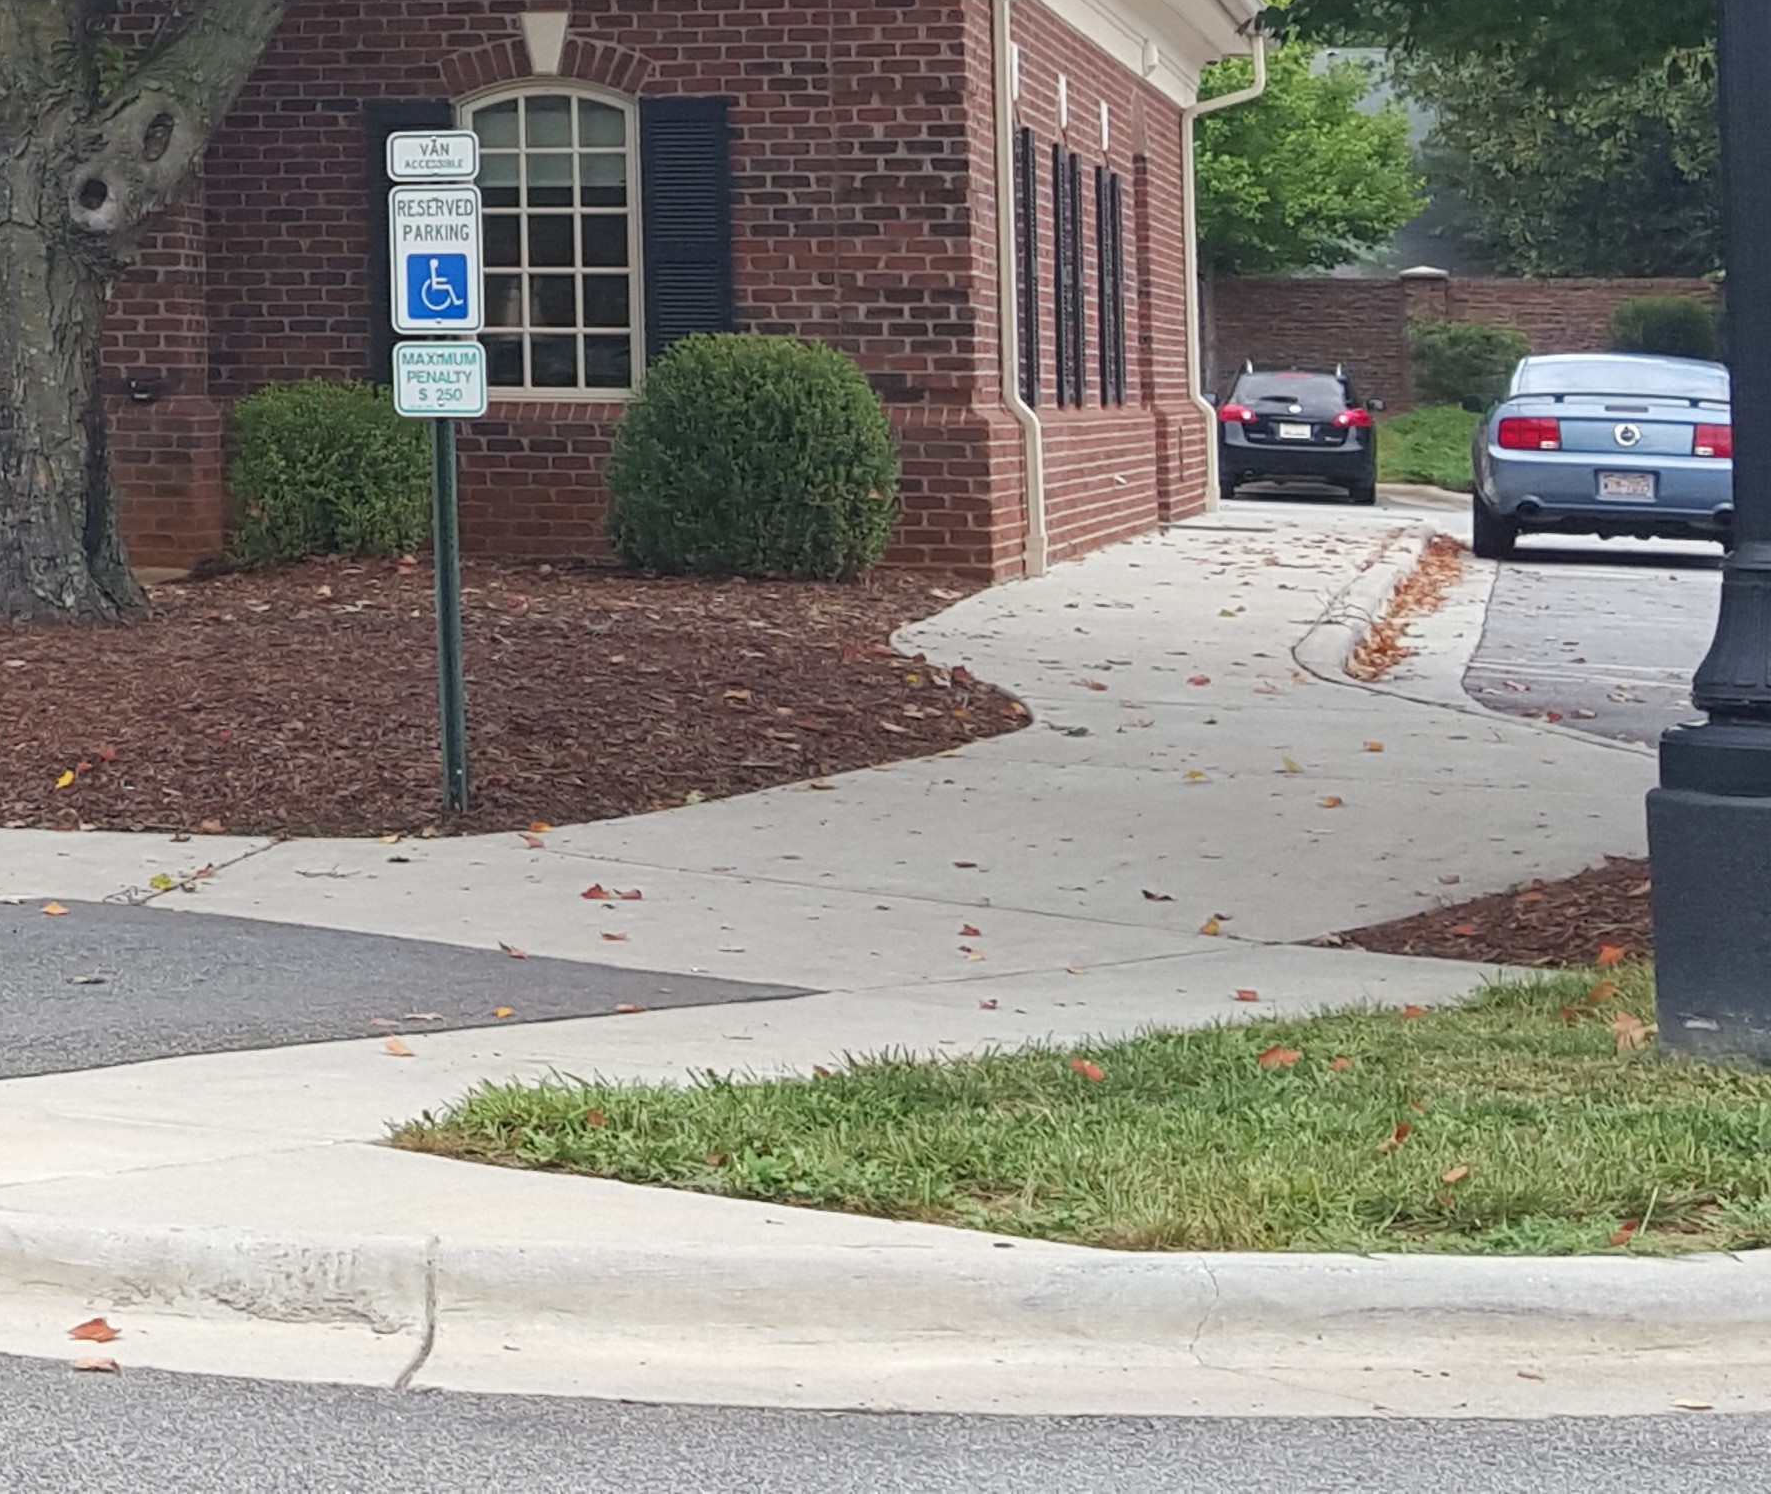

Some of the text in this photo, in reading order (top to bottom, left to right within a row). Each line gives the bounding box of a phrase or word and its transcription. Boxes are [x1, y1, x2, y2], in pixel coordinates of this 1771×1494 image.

[419, 142, 450, 157] VAN
[404, 159, 464, 169] ACCESSIBLE
[397, 199, 474, 217] RESERVED
[403, 224, 469, 242] PARKING
[402, 352, 477, 365] MAXIMUM
[406, 370, 472, 384] PENALTY
[418, 388, 463, 401] $ 250
